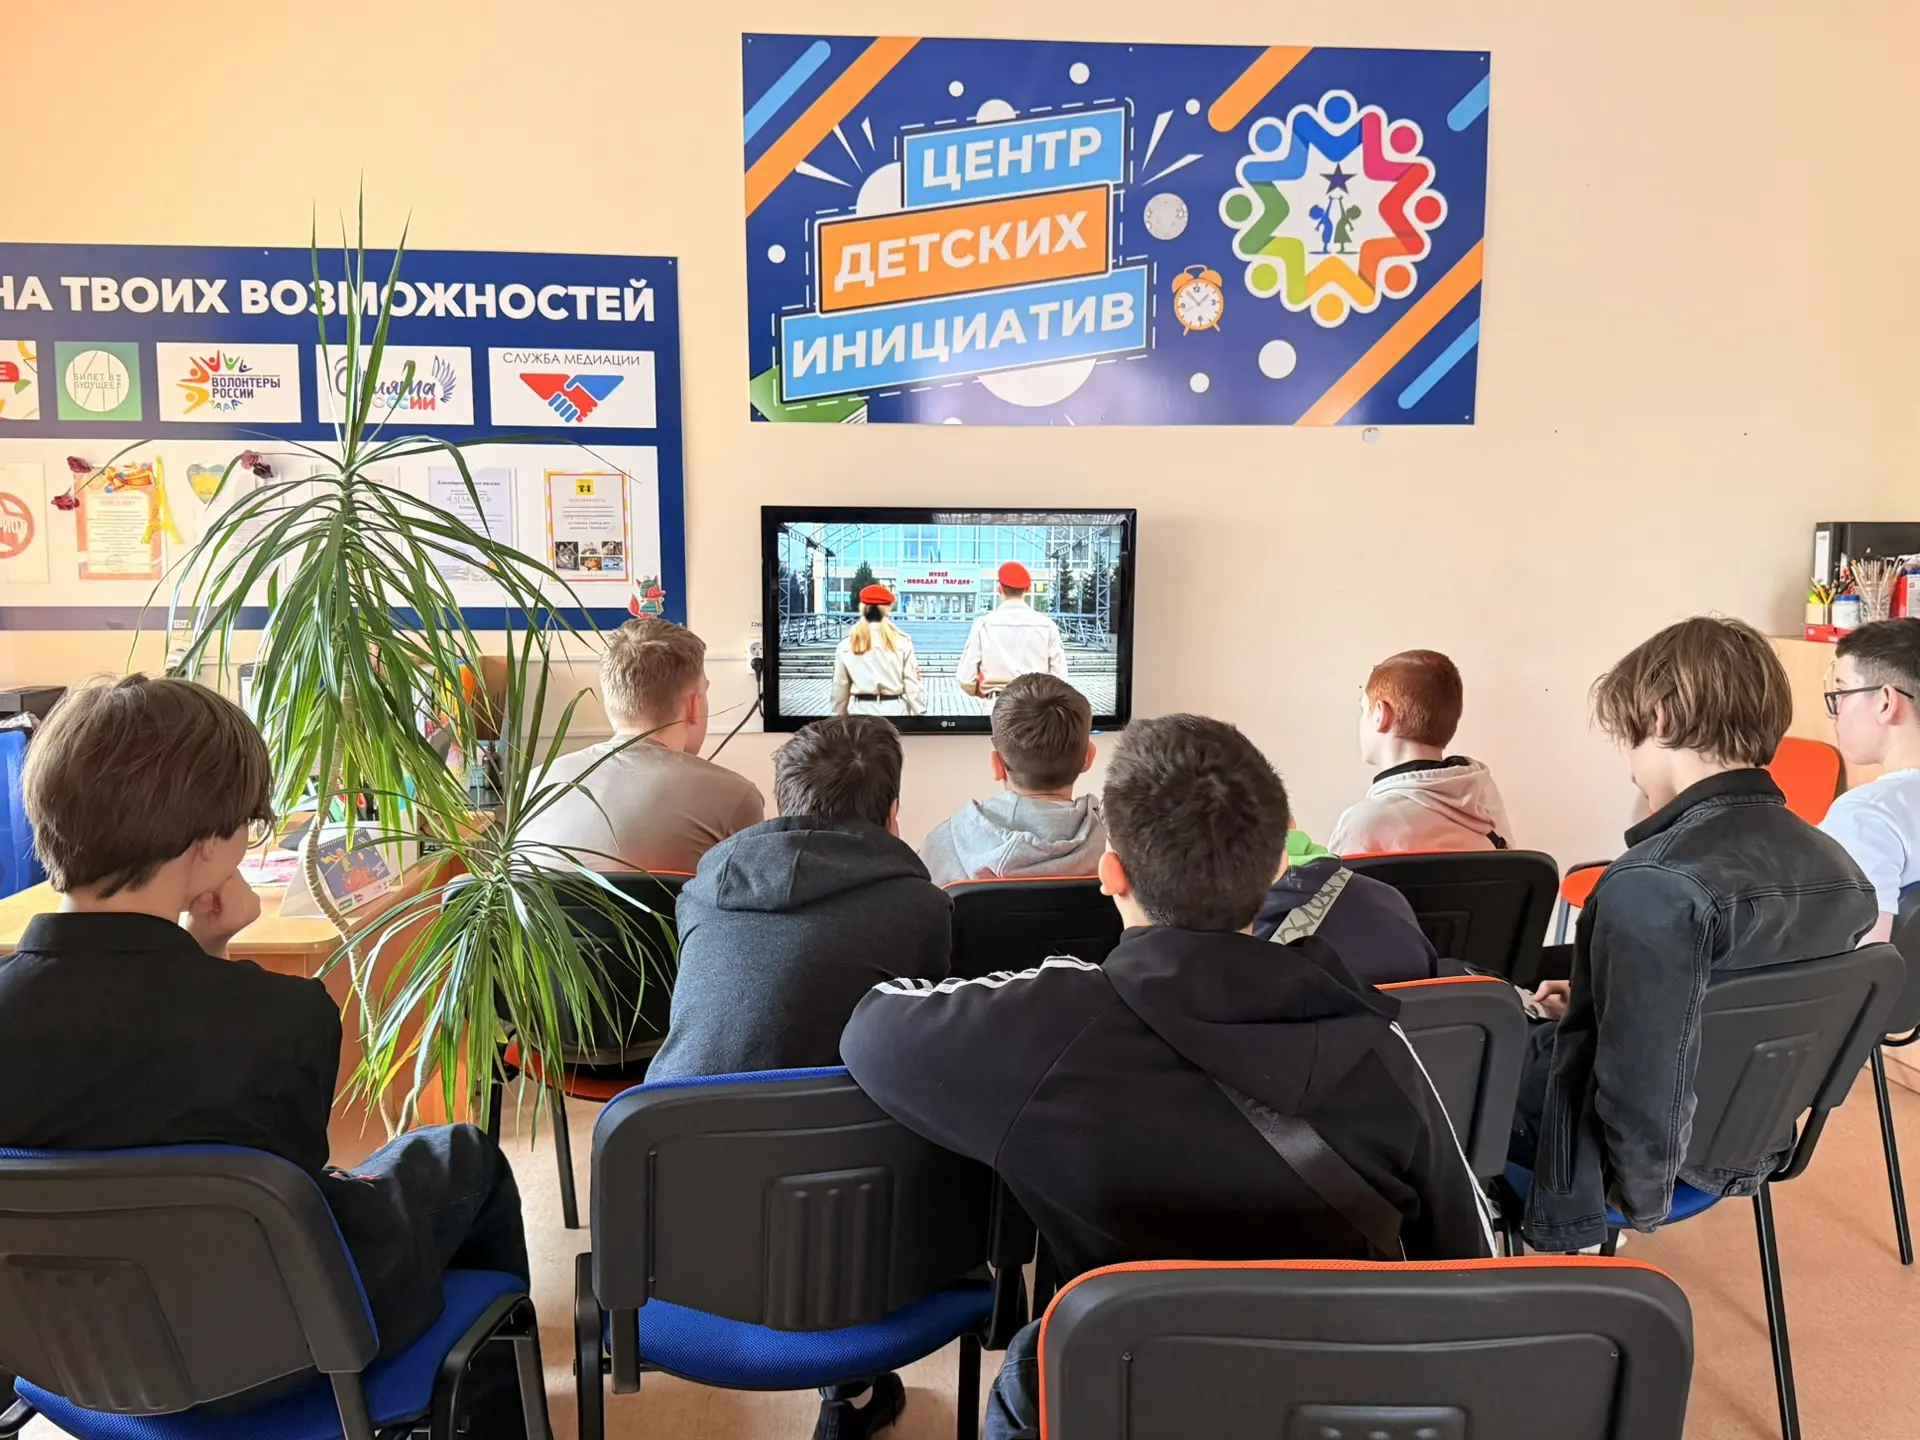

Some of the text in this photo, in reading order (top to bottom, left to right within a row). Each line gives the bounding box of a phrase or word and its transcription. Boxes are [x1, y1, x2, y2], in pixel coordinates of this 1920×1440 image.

[922, 126, 1103, 191] ЦЕНТР
[832, 211, 1088, 292] ДЕТСКИХ
[60, 276, 231, 314] ТВОИХ
[240, 278, 656, 323] ВОЗМОЖНОСТЕЙ
[792, 291, 1136, 379] ИНИЦИАТИВ
[503, 352, 641, 366] СЛУЖБА МЕДИАЦИИ
[73, 373, 105, 381] БИЛЕТ
[212, 377, 281, 389] ВОЛОНТЕРЫ
[73, 381, 116, 390] БУДУЩЕЕ
[212, 388, 254, 399] РОССИИ
